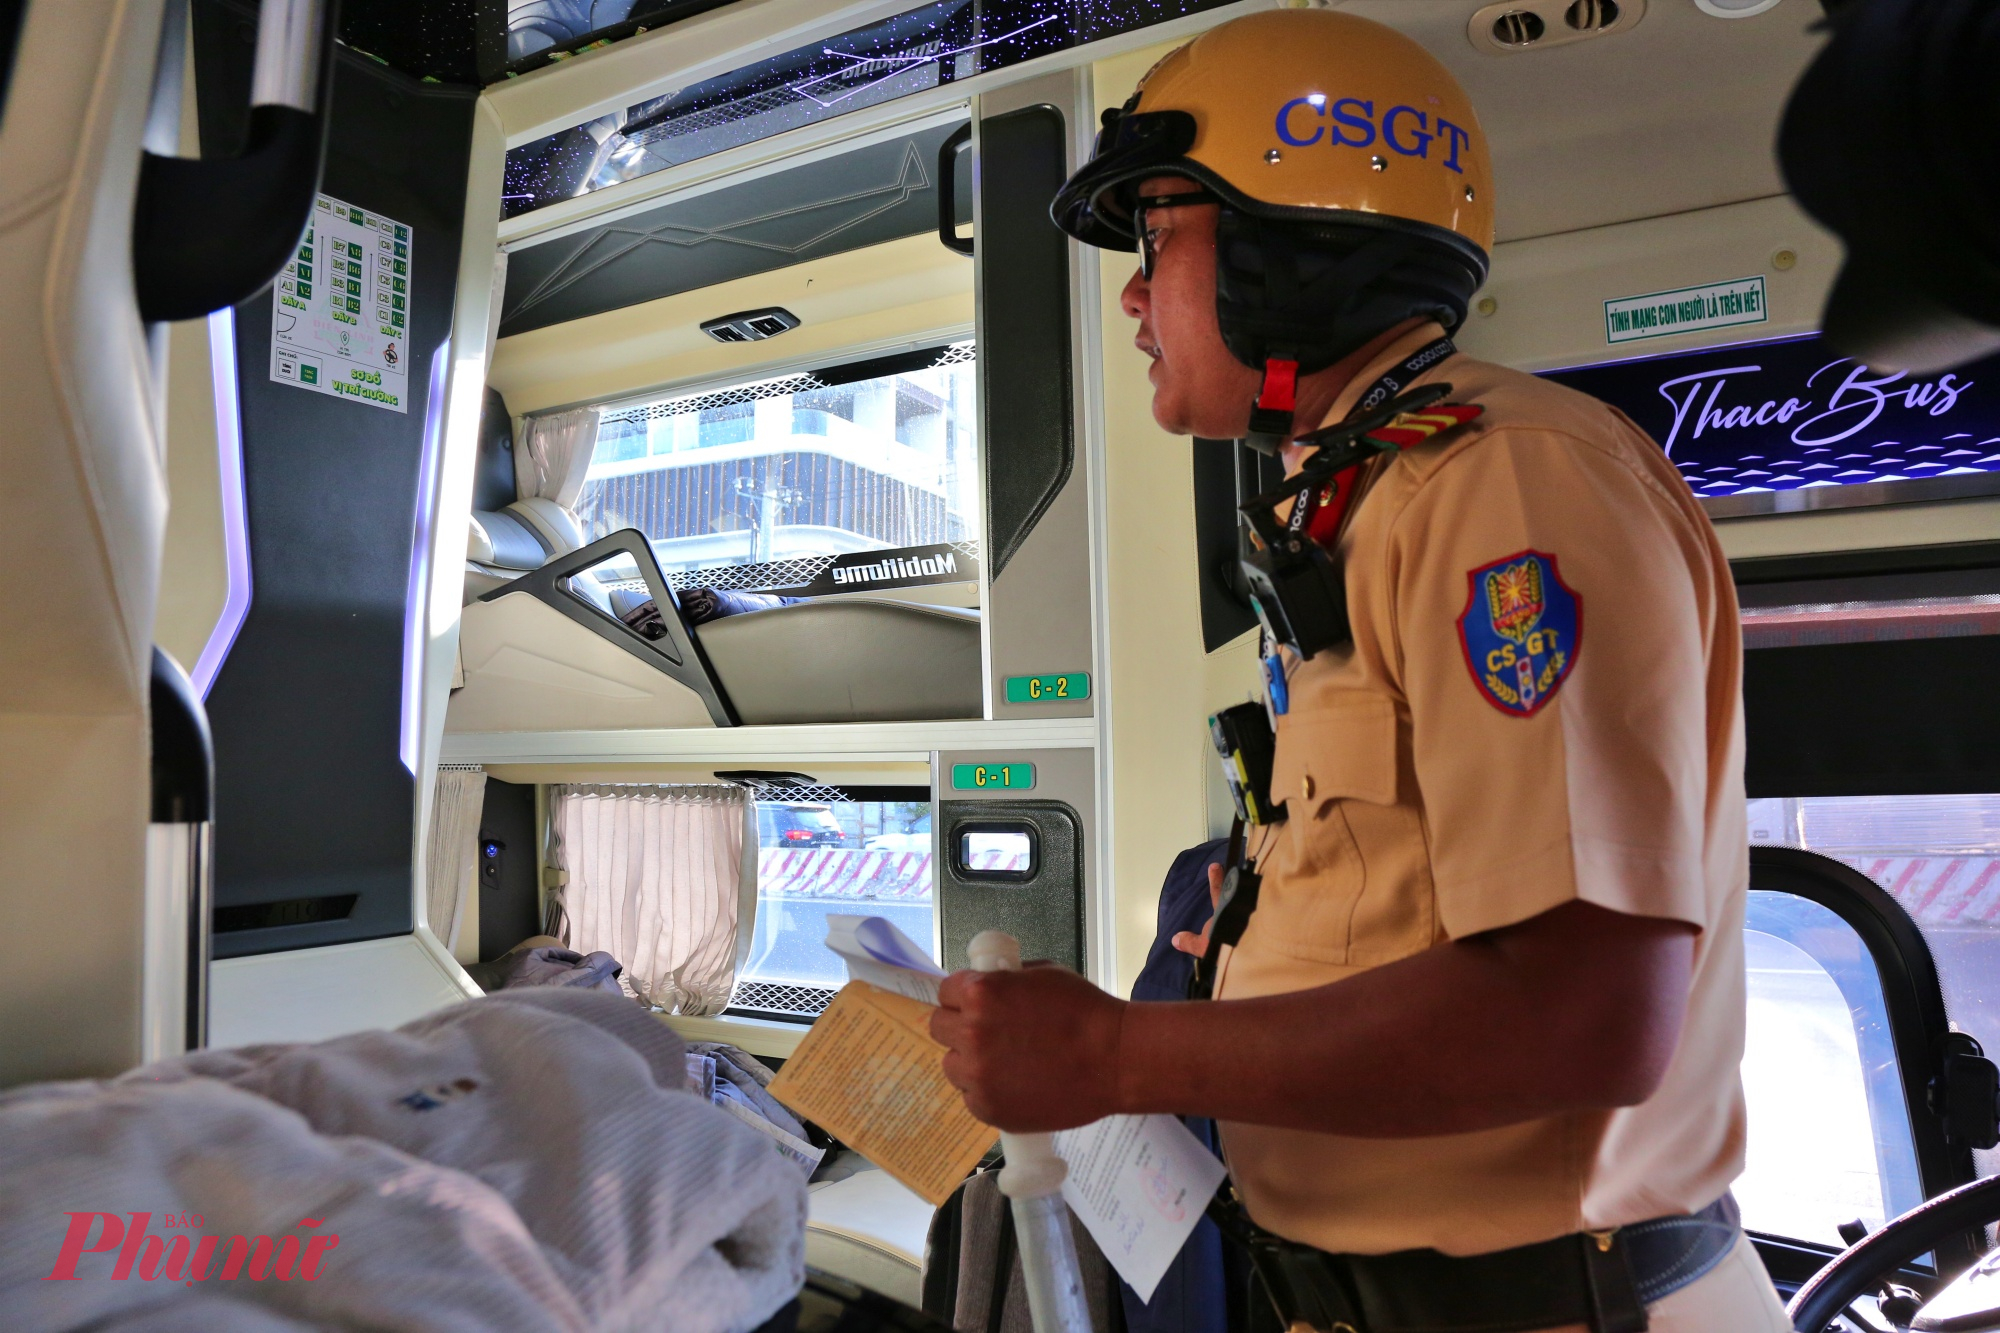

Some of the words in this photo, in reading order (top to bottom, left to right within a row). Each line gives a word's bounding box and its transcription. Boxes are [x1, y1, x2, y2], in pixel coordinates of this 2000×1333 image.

[1275, 97, 1469, 174] CSGT
[1610, 308, 1631, 333] TÍNH
[1631, 306, 1657, 333] MẠNG
[1658, 302, 1677, 326] CON
[1678, 294, 1706, 323] NGƯỜI
[1707, 292, 1719, 319] LÀ
[1719, 289, 1743, 316] TRÊN
[1744, 284, 1761, 313] HẾT
[1658, 365, 1812, 459] Thaco
[1791, 356, 1974, 446] Bus
